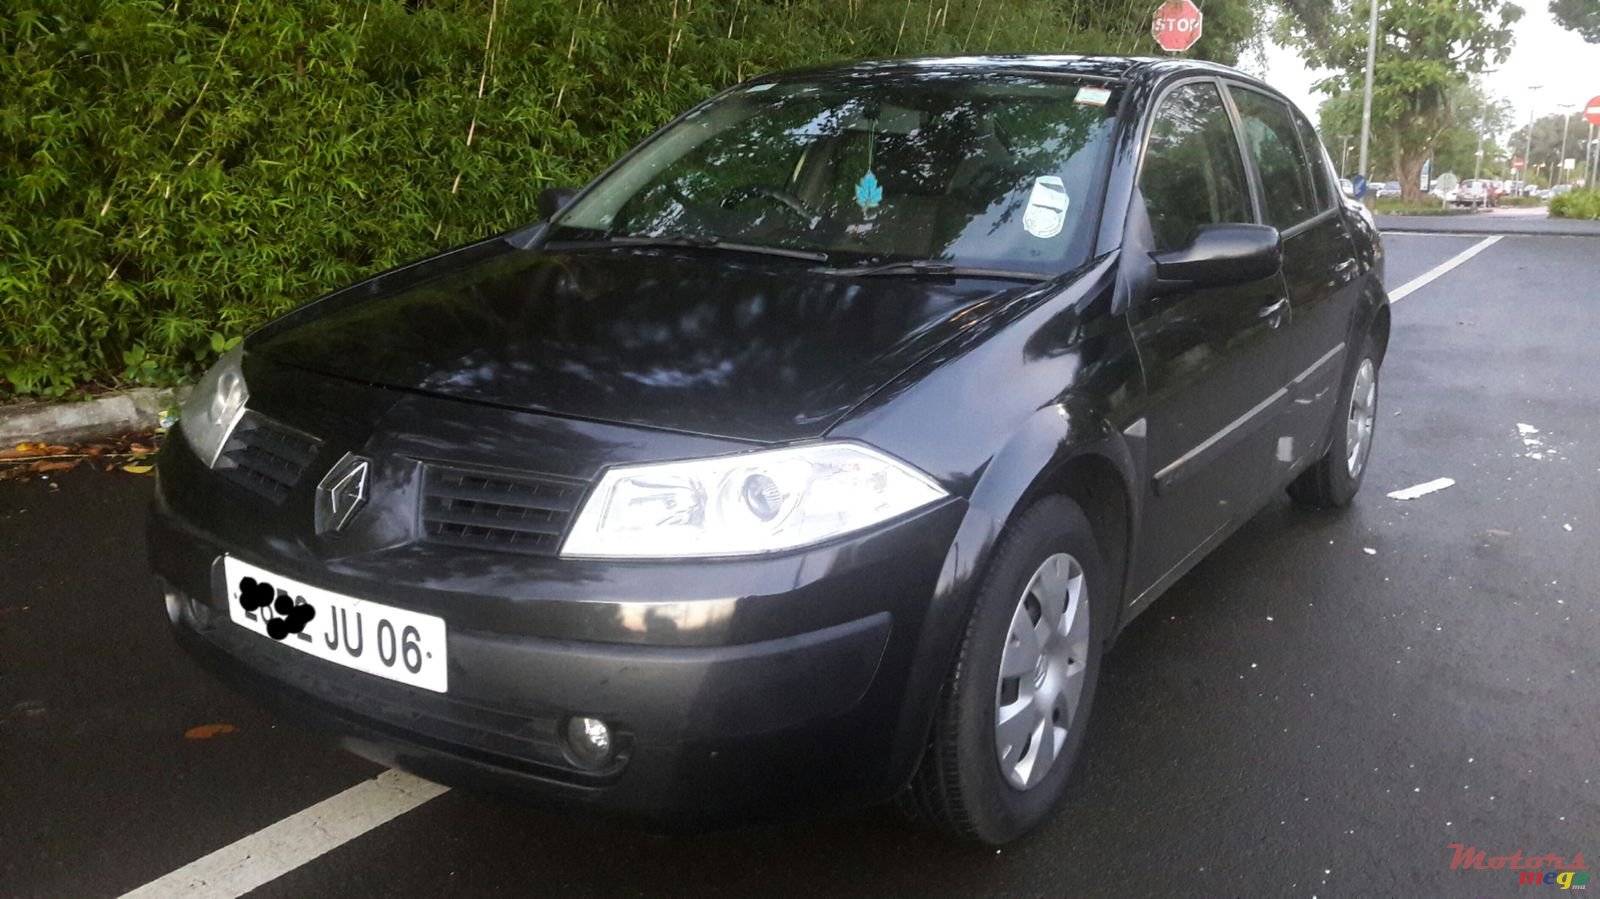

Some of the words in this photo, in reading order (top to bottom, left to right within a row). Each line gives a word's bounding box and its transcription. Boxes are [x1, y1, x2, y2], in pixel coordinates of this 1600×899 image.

[1155, 18, 1200, 32] STOP
[324, 605, 363, 658] JU
[377, 618, 422, 674] 06
